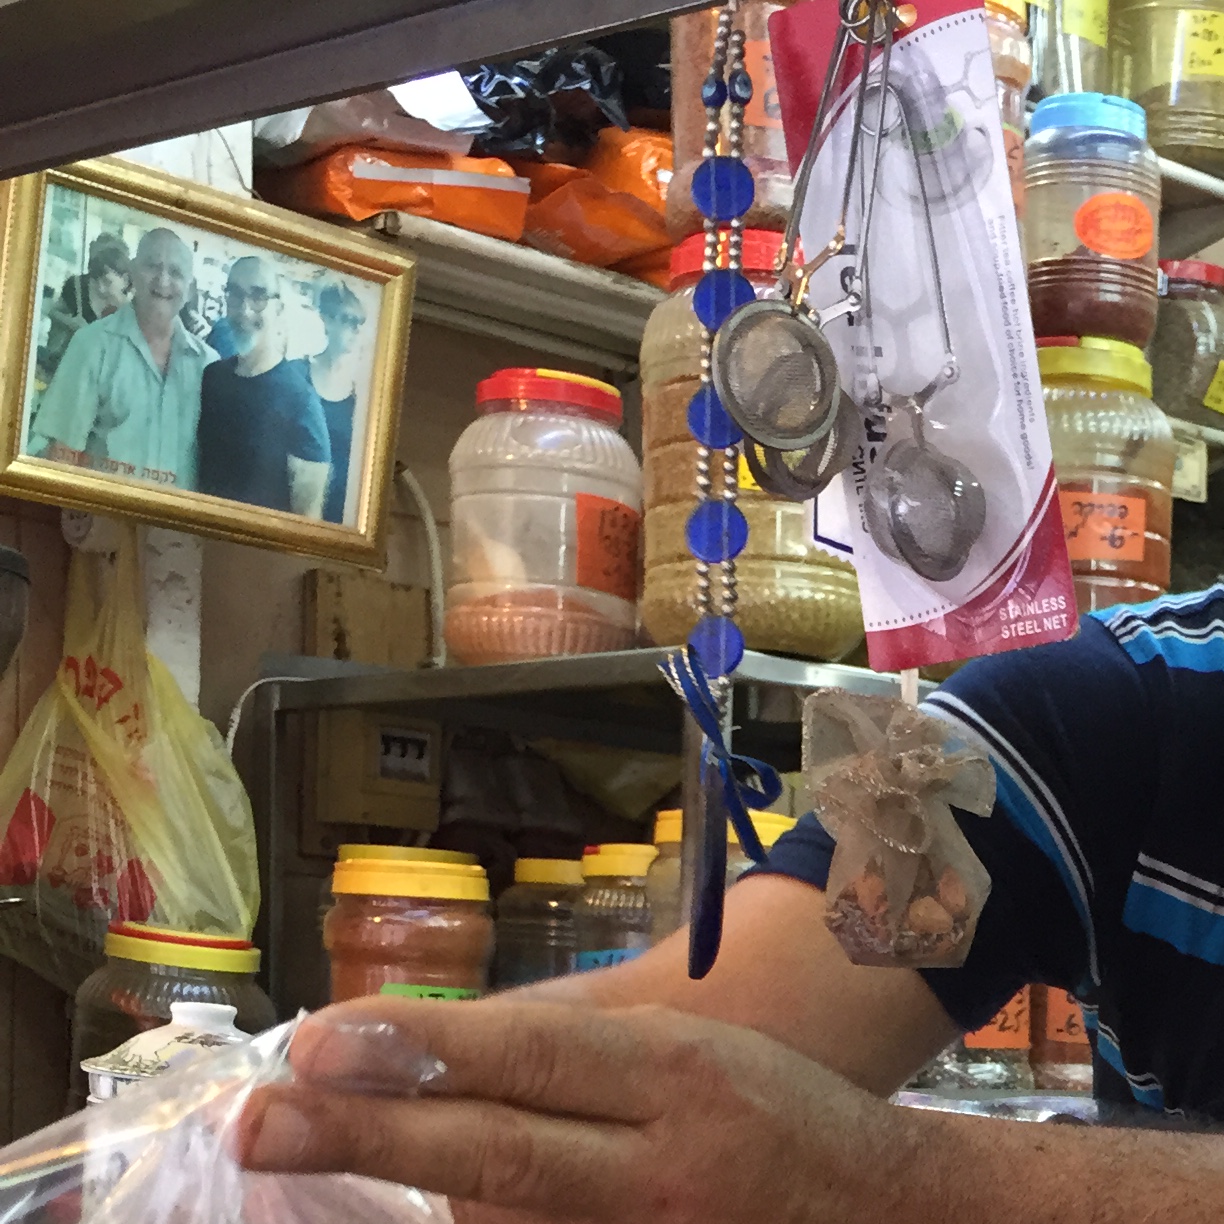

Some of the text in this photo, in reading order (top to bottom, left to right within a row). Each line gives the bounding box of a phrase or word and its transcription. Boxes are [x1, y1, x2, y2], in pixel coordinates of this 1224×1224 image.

[999, 595, 1067, 621] STAINLESS
[1001, 613, 1068, 640] STEEL NET
